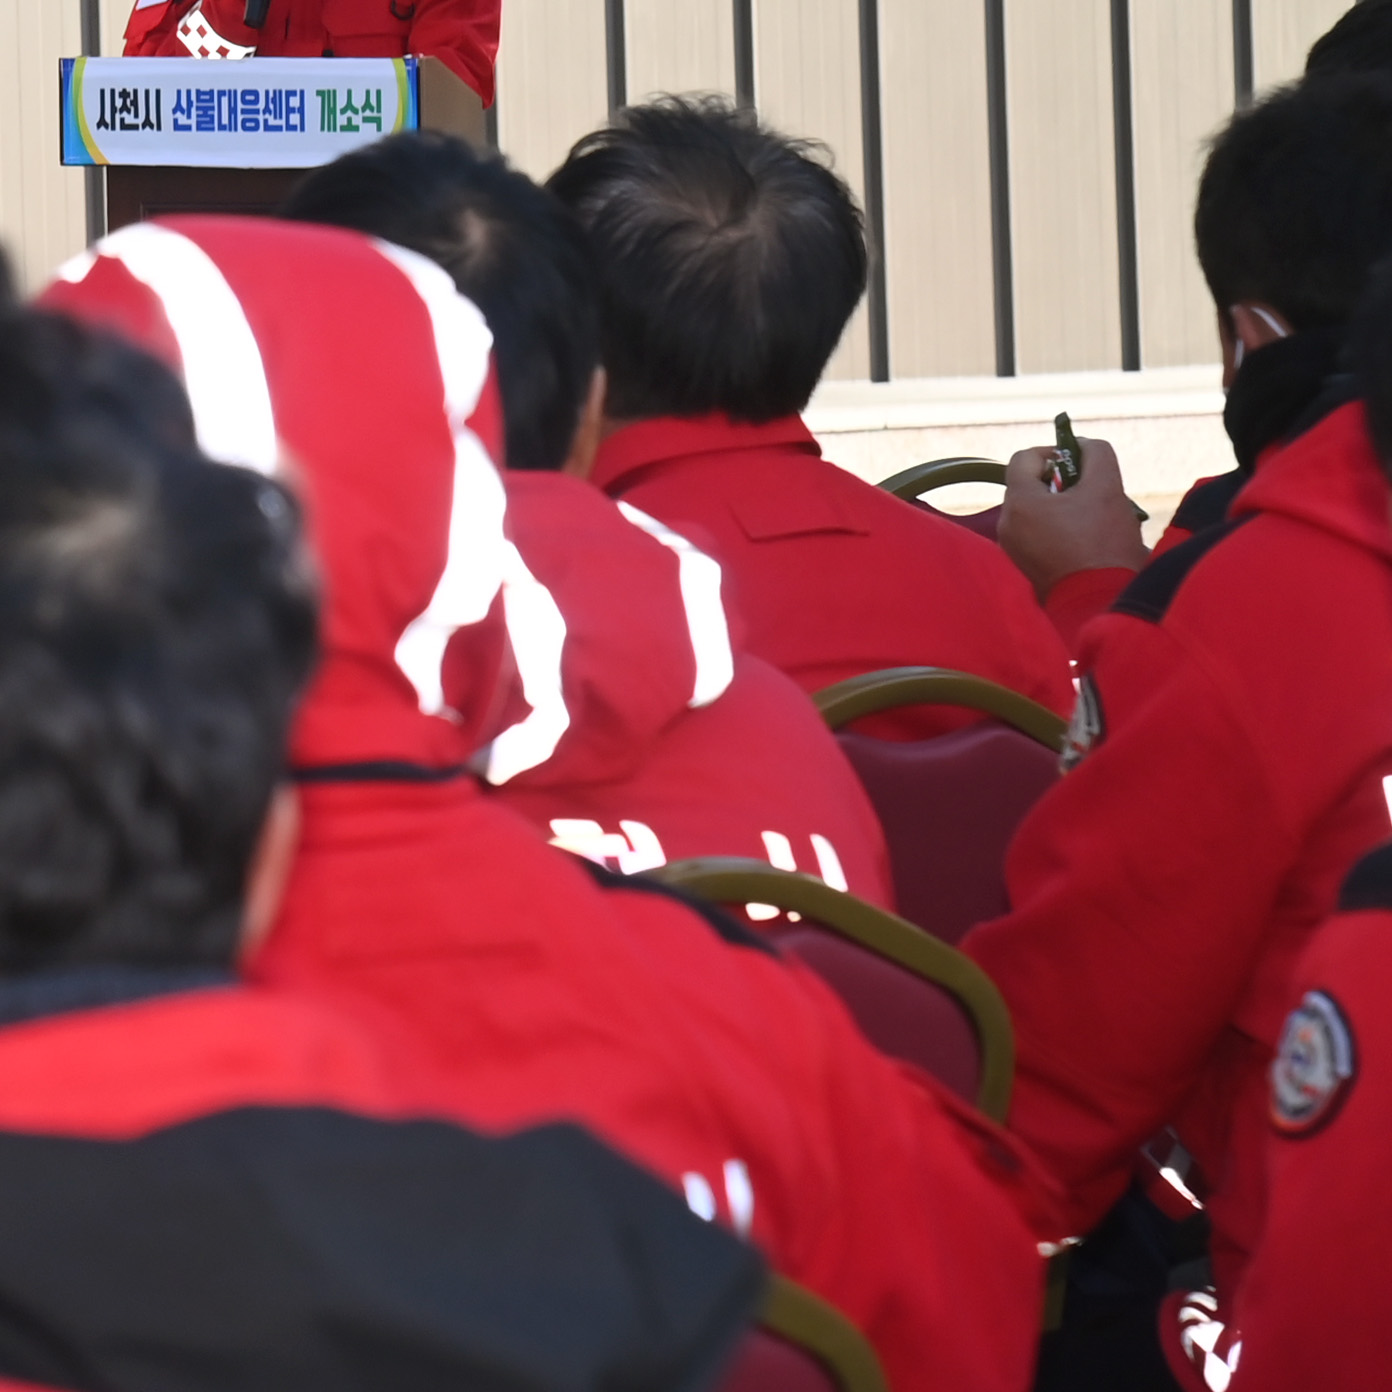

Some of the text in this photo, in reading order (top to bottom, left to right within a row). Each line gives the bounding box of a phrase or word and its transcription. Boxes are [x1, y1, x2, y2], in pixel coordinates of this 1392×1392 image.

[96, 88, 383, 132] 사천시 산불대응센터 개소식
